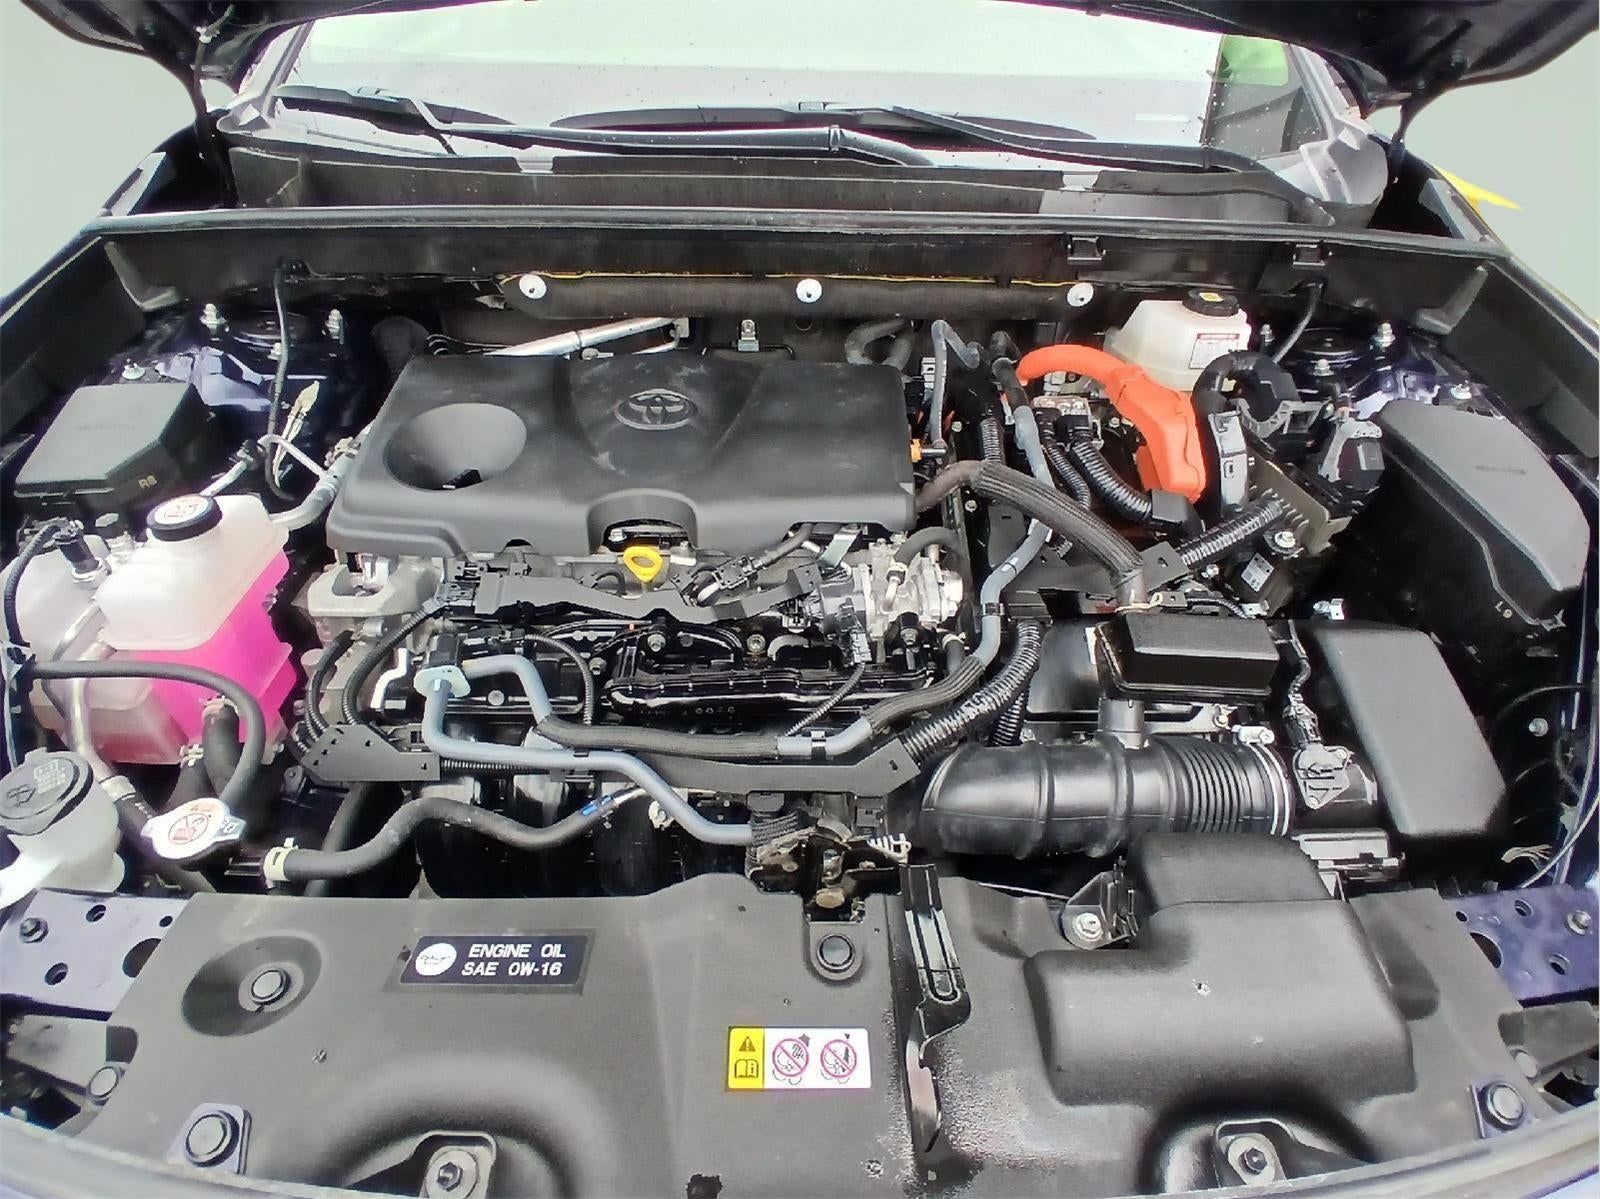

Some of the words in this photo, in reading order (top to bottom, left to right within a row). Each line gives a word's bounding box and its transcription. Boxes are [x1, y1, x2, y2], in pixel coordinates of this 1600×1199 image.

[468, 943, 532, 958] ENGINE
[540, 943, 566, 958] OIL
[461, 961, 499, 976] SAE
[508, 961, 563, 976] 0W-16
